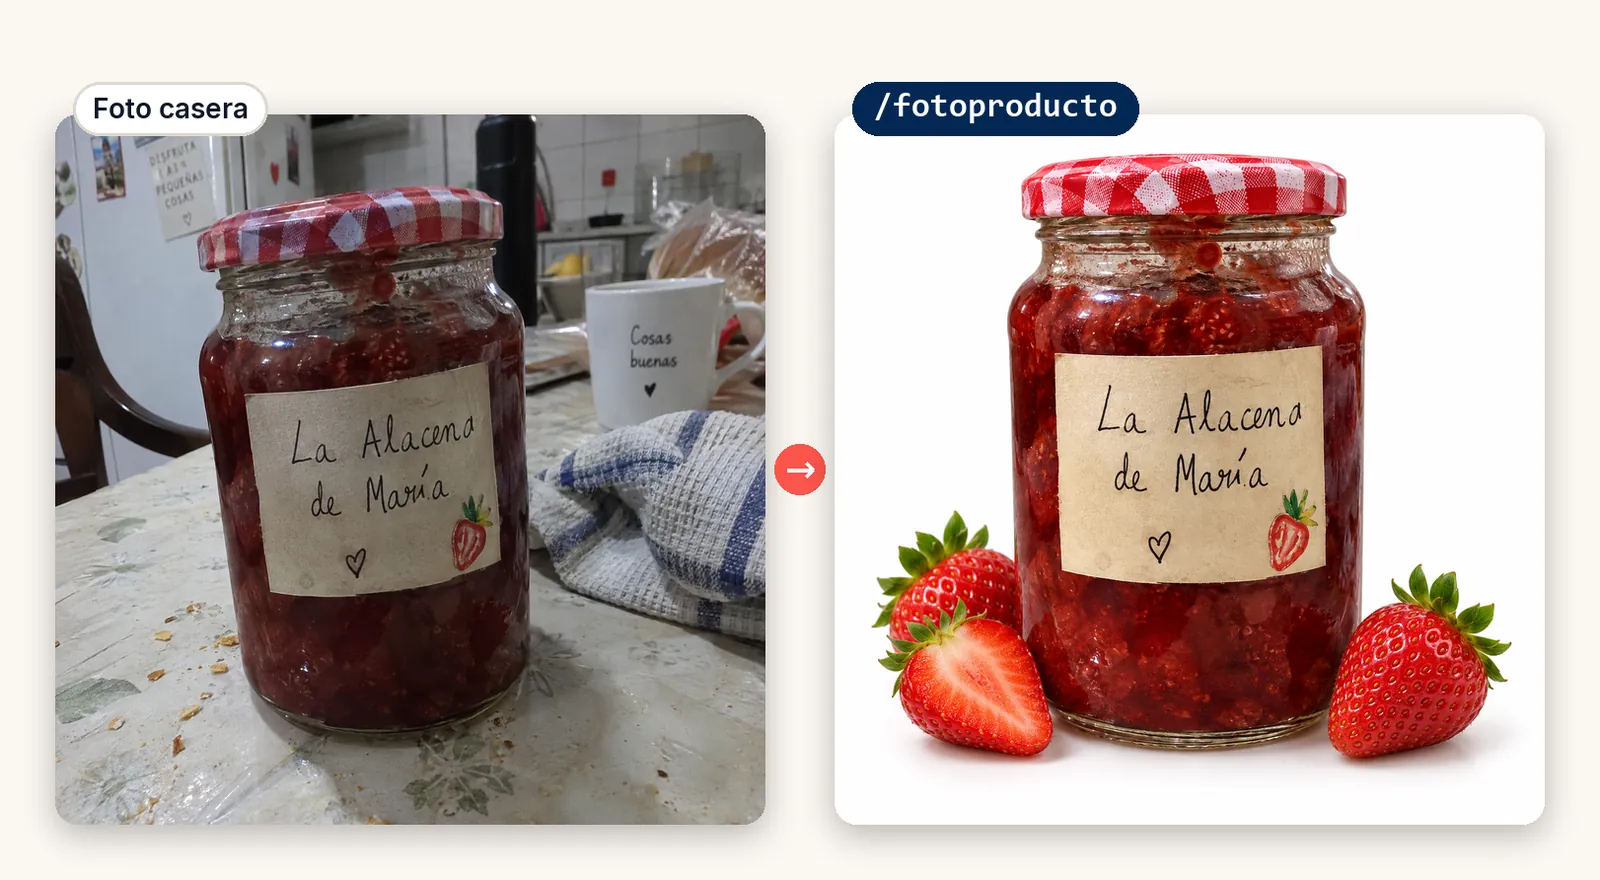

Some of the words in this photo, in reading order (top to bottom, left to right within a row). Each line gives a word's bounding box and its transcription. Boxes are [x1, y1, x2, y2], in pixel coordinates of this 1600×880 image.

[149, 140, 197, 167] DISFRUTA
[156, 169, 204, 196] PEQUEÑAS
[164, 190, 195, 209] COSAS
[630, 324, 672, 346] Cosas
[630, 348, 678, 368] buenas
[1097, 384, 1147, 434] La
[1173, 389, 1302, 434] Alacena
[291, 419, 337, 465] La
[361, 413, 475, 459] Alacena
[1114, 451, 1148, 492] de
[1175, 447, 1269, 496] María
[310, 480, 342, 517] de
[366, 463, 449, 514] María
